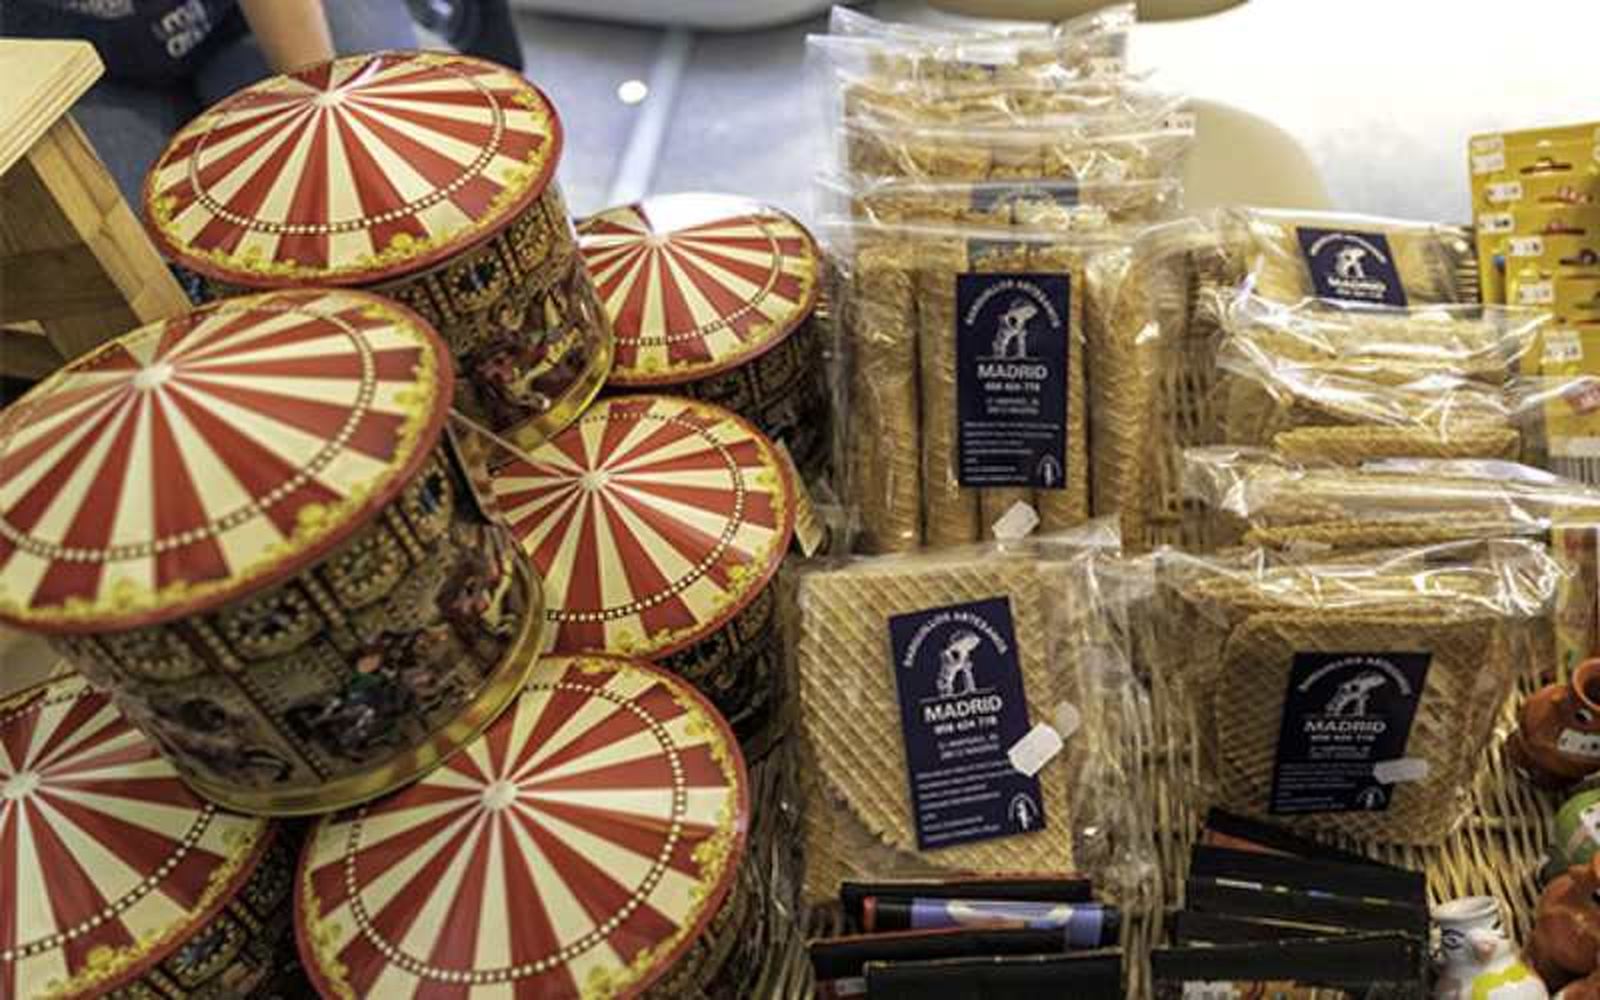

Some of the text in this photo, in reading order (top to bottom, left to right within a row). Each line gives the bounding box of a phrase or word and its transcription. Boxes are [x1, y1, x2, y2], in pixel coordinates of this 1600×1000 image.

[977, 364, 1048, 380] MADRID
[923, 696, 1003, 722] MADRID
[1303, 720, 1387, 733] MADRID
